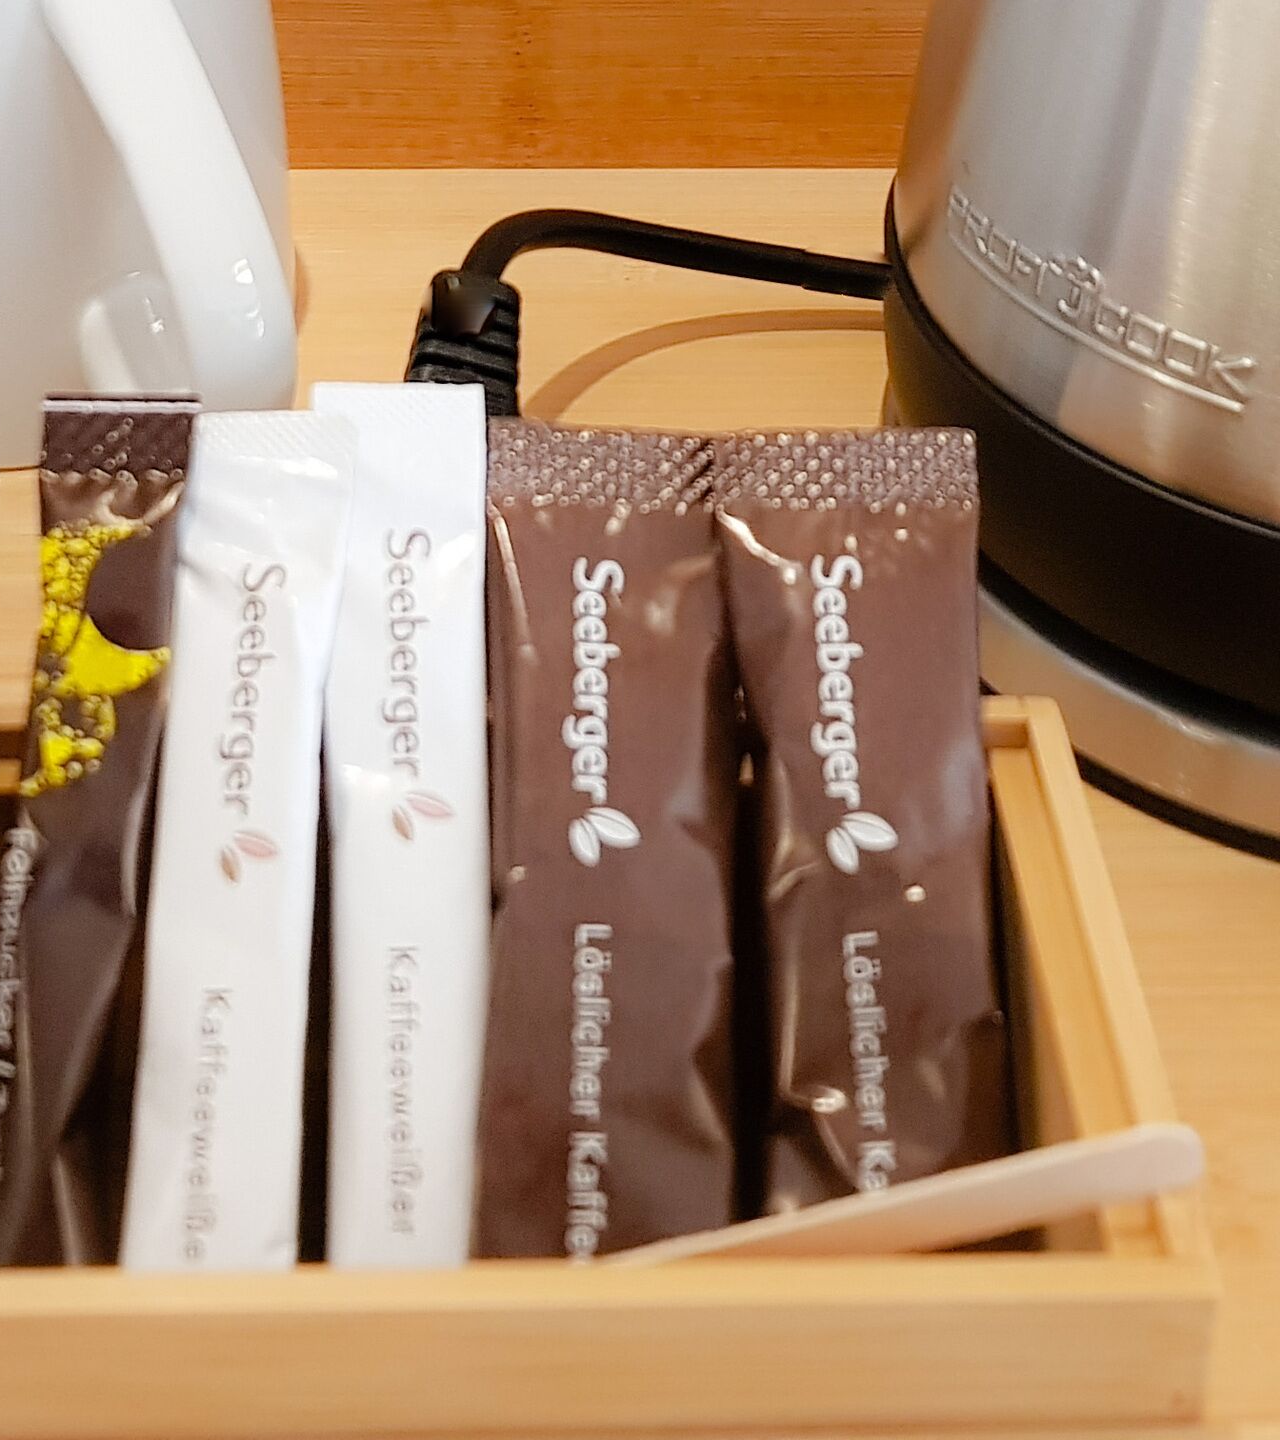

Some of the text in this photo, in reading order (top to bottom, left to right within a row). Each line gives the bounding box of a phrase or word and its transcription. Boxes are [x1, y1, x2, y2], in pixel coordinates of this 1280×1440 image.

[219, 562, 287, 816] Seeberger
[381, 526, 432, 778] Seeberger
[562, 555, 625, 806] Seeberger
[810, 553, 864, 810] Seeberger
[571, 923, 614, 1122] Löslicher
[842, 930, 892, 1131] Löslicher
